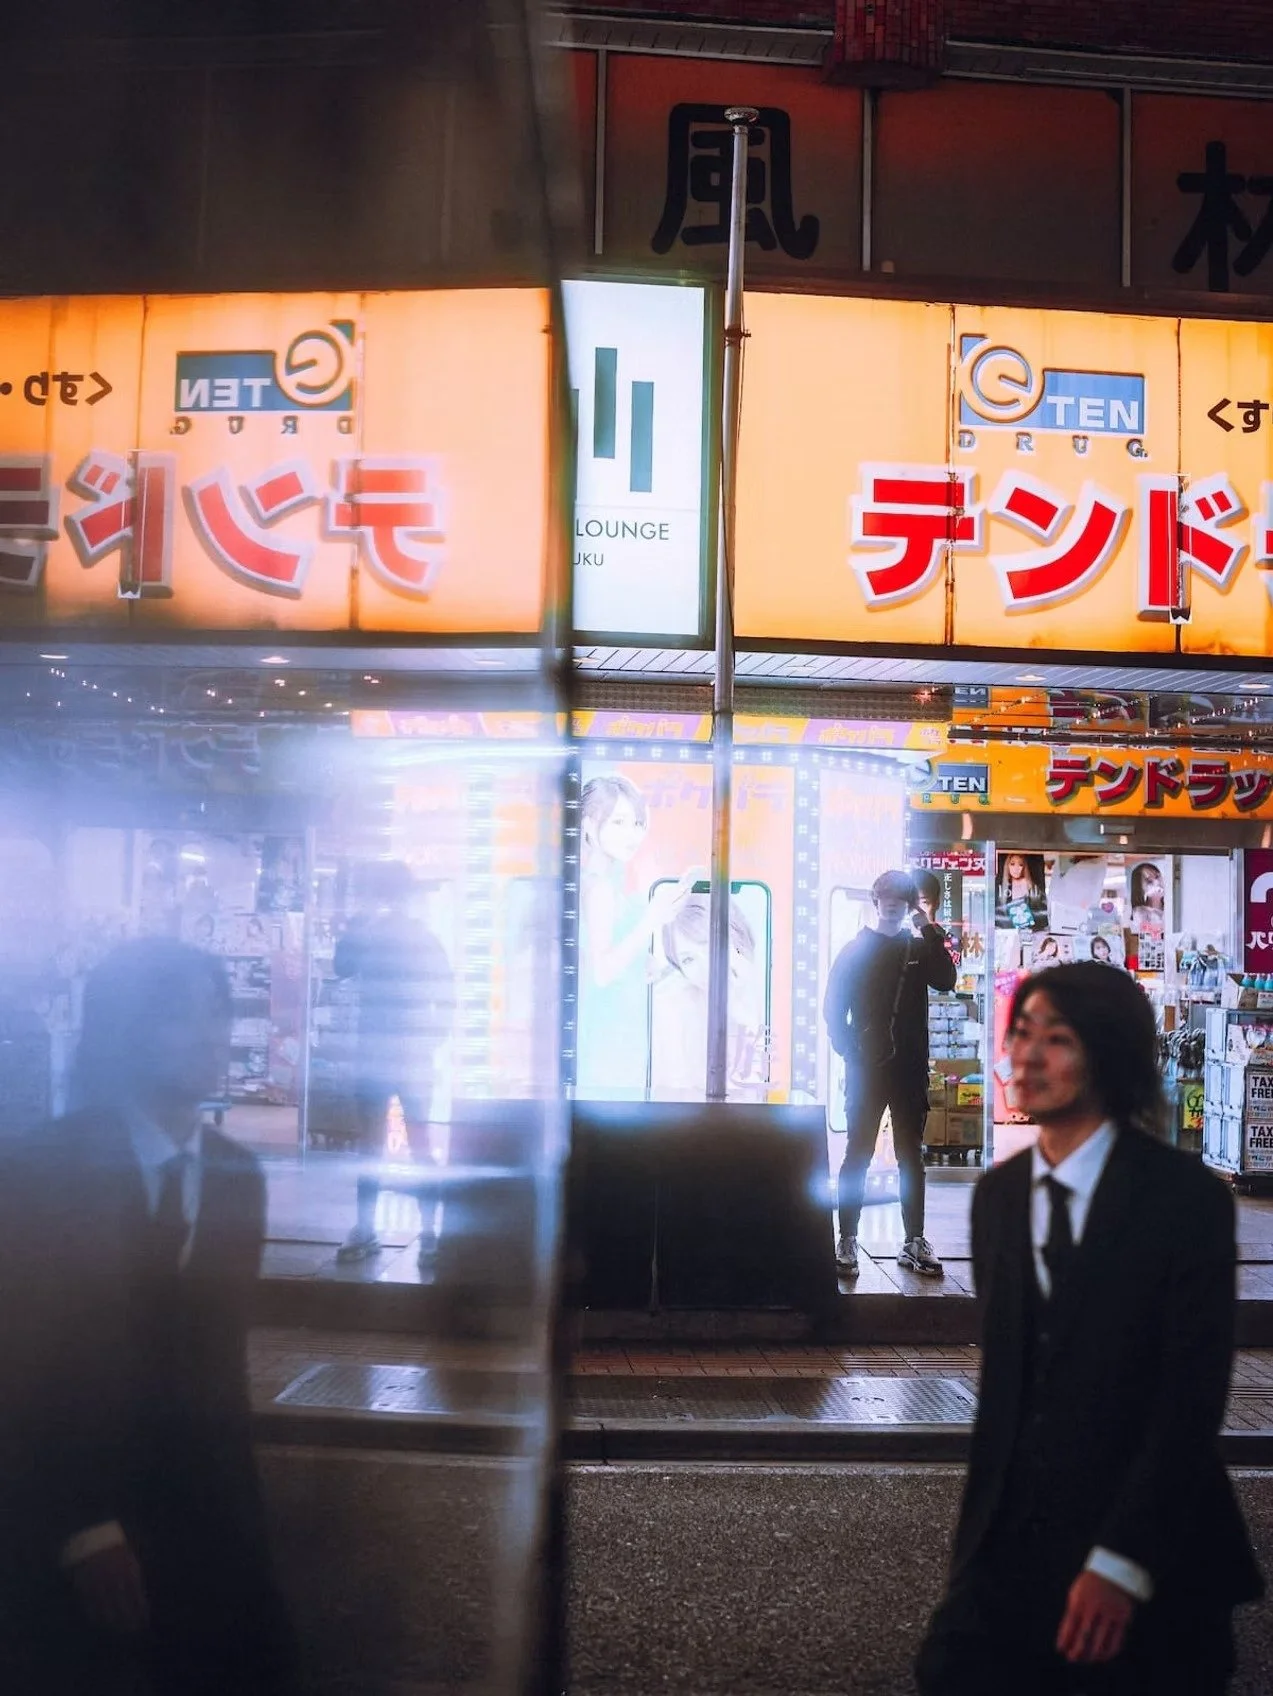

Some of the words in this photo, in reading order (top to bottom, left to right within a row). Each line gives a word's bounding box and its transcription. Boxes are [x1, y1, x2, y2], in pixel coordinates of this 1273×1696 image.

[650, 103, 820, 261] 風
[1046, 395, 1141, 431] TEN
[1207, 398, 1273, 433] くす
[576, 518, 670, 541] LOUNGE
[851, 463, 1273, 622] テンド
[938, 776, 987, 792] TEN
